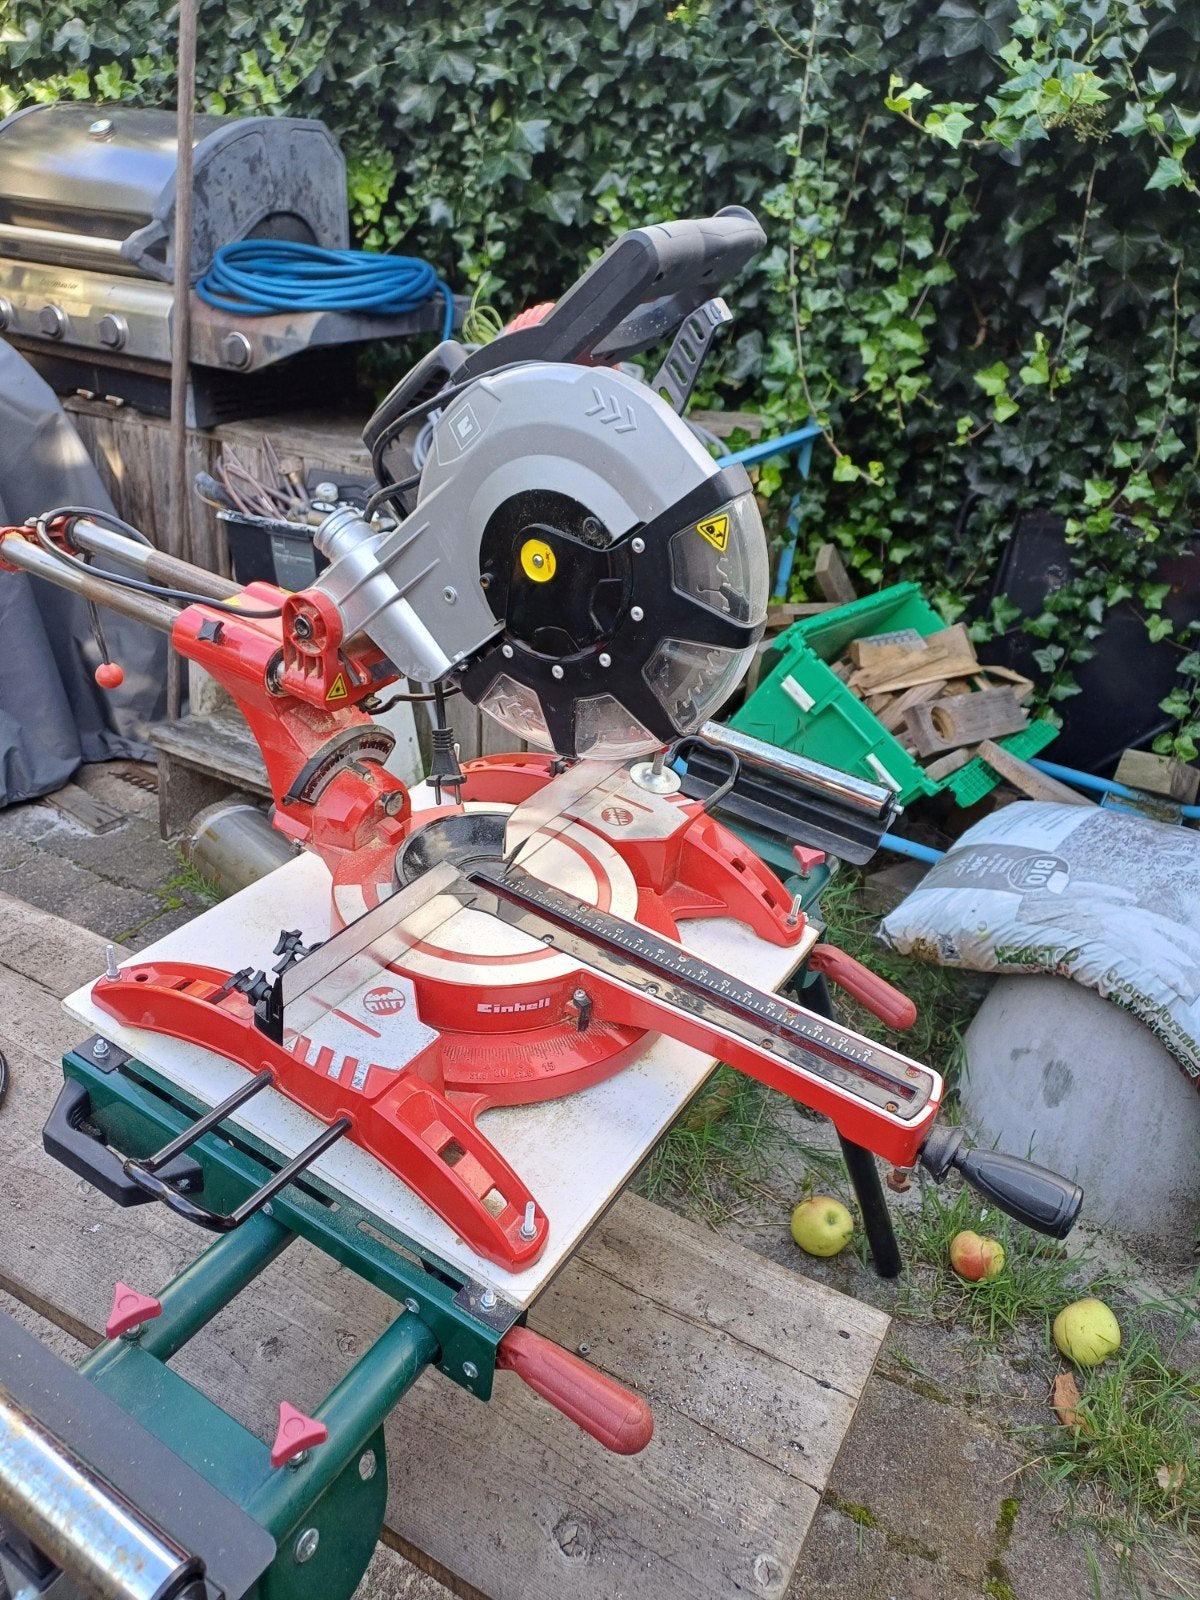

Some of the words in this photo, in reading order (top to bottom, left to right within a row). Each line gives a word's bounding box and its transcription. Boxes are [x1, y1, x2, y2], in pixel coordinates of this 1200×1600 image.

[1025, 859, 1058, 885] BIO
[477, 998, 550, 1013] Einhell
[542, 1061, 556, 1072] 15
